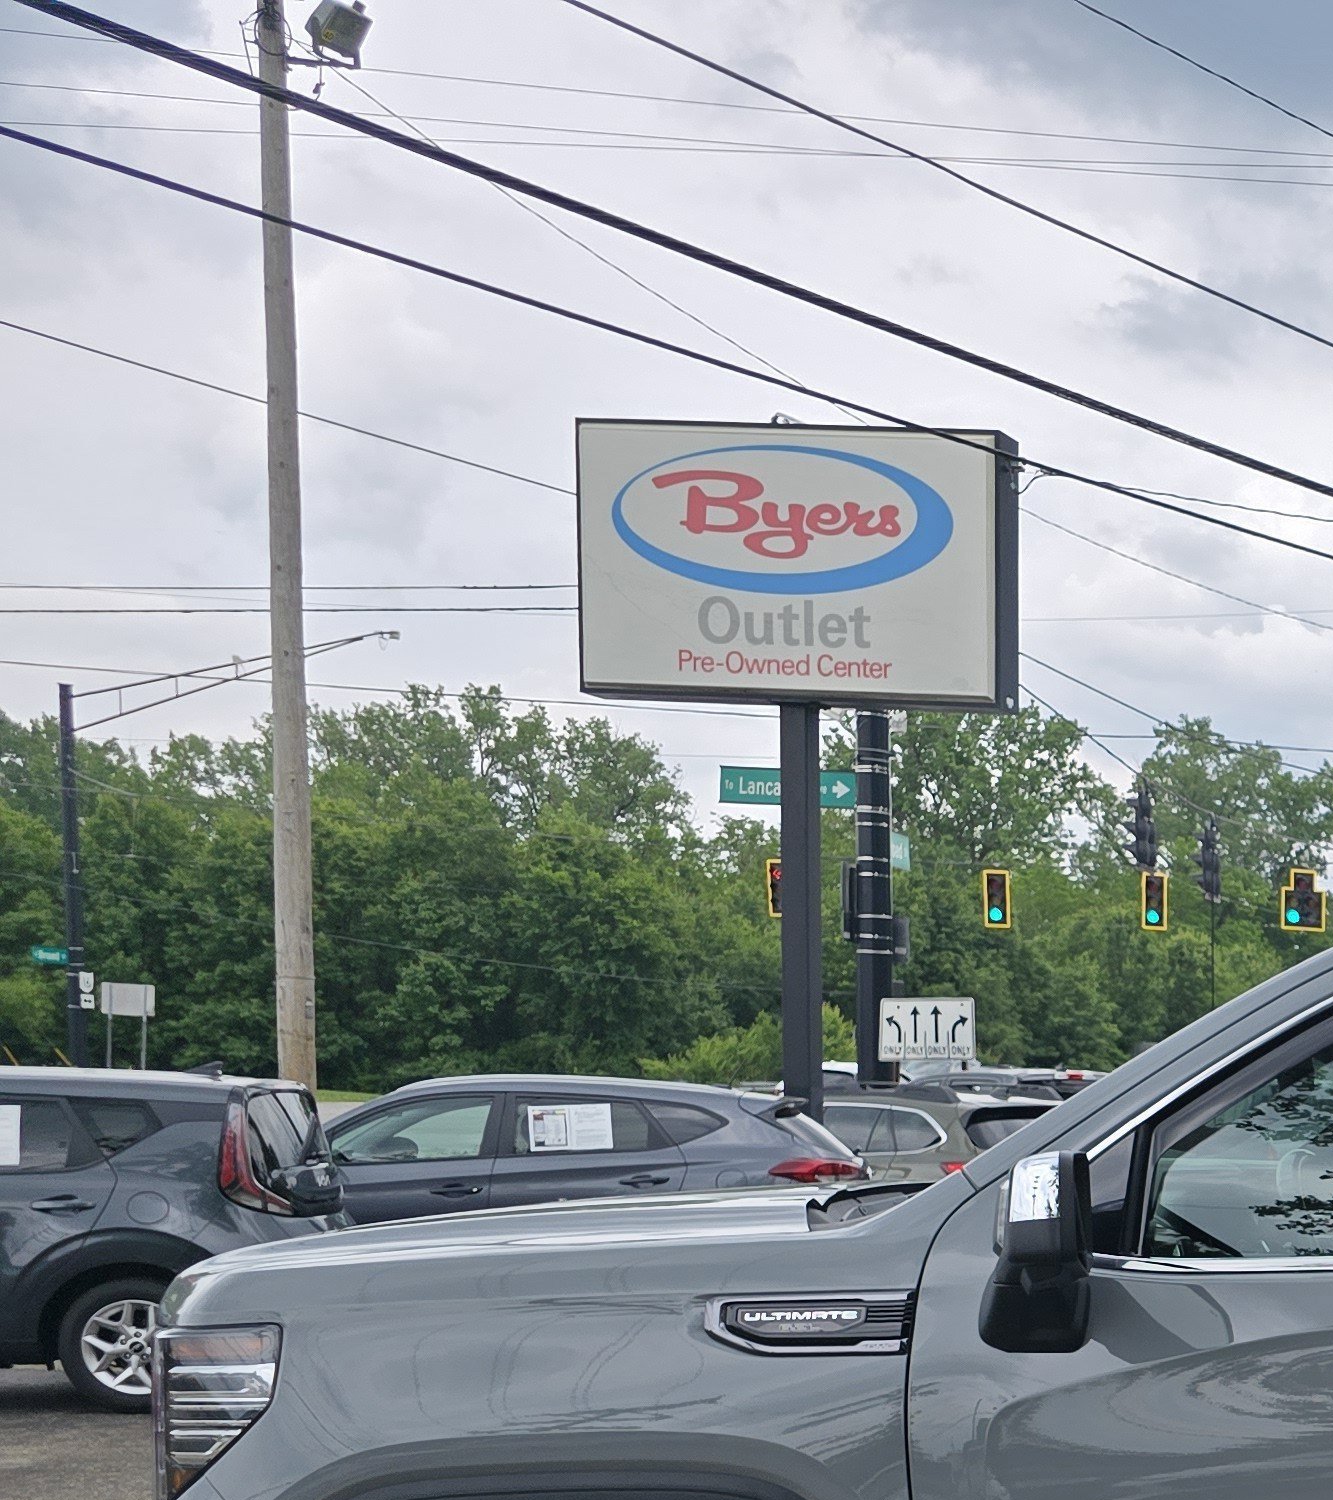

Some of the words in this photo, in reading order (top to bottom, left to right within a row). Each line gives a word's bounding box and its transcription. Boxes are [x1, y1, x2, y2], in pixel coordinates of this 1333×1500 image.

[651, 469, 901, 559] Byers
[697, 595, 871, 649] Outlet
[678, 649, 811, 676] Pre-Owned
[816, 653, 893, 679] Center
[739, 776, 781, 797] Lanca
[906, 1045, 923, 1056] ONLY
[928, 1045, 946, 1056] ONLY
[951, 1045, 971, 1056] ONLY
[743, 1310, 858, 1322] ULTIMATE
